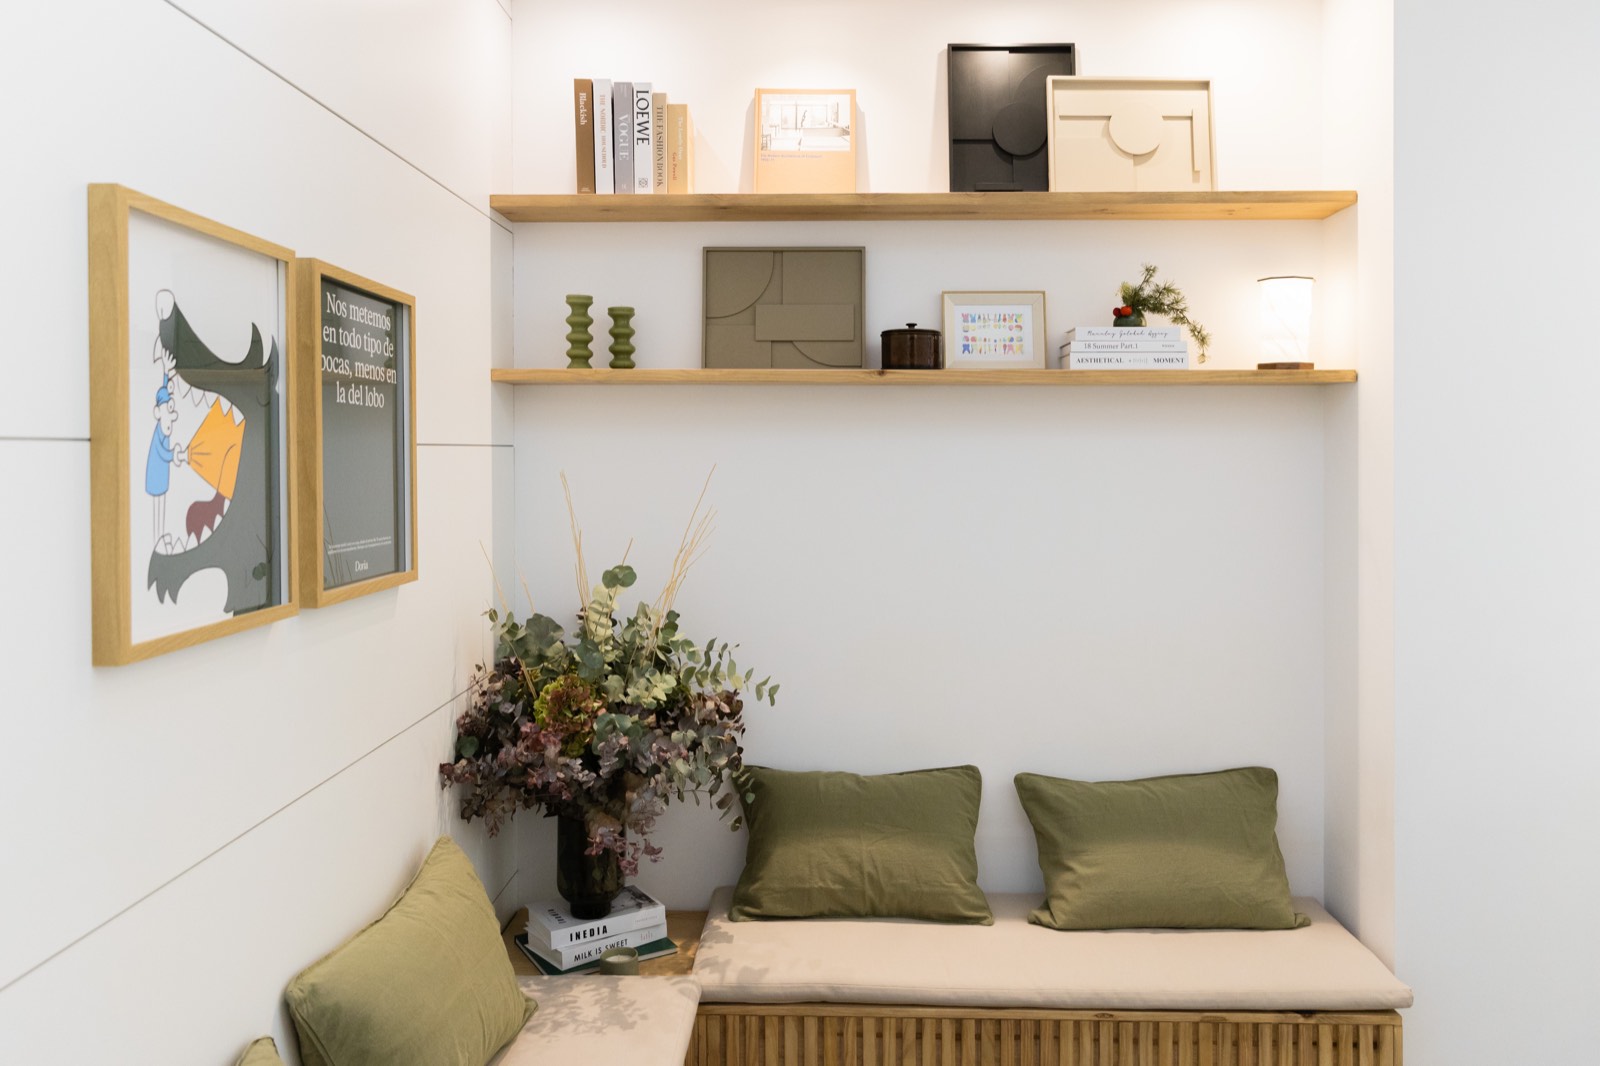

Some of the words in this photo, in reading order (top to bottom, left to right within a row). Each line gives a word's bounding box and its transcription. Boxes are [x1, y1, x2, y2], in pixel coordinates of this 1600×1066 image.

[579, 92, 588, 126] Blackish
[636, 90, 650, 146] LOEWE
[656, 106, 664, 123] THE
[618, 114, 629, 161] VOGUE
[656, 124, 664, 165] FASHION
[656, 165, 664, 187] BOOK
[326, 291, 348, 319] Nos
[349, 303, 391, 332] metemos
[322, 324, 338, 345] en
[338, 328, 363, 351] todo
[363, 332, 382, 358] tipo
[383, 336, 395, 358] de
[1083, 342, 1093, 350] 18
[1092, 342, 1120, 350] Summer
[1120, 342, 1139, 350] Part.1
[354, 360, 386, 383] menos
[386, 366, 398, 385] en
[336, 381, 347, 404] la
[347, 383, 364, 406] del
[365, 385, 386, 409] lobo
[569, 925, 608, 942] INEDIA
[574, 950, 593, 962] MILK
[595, 946, 603, 956] IS
[605, 938, 629, 951] SWEET
